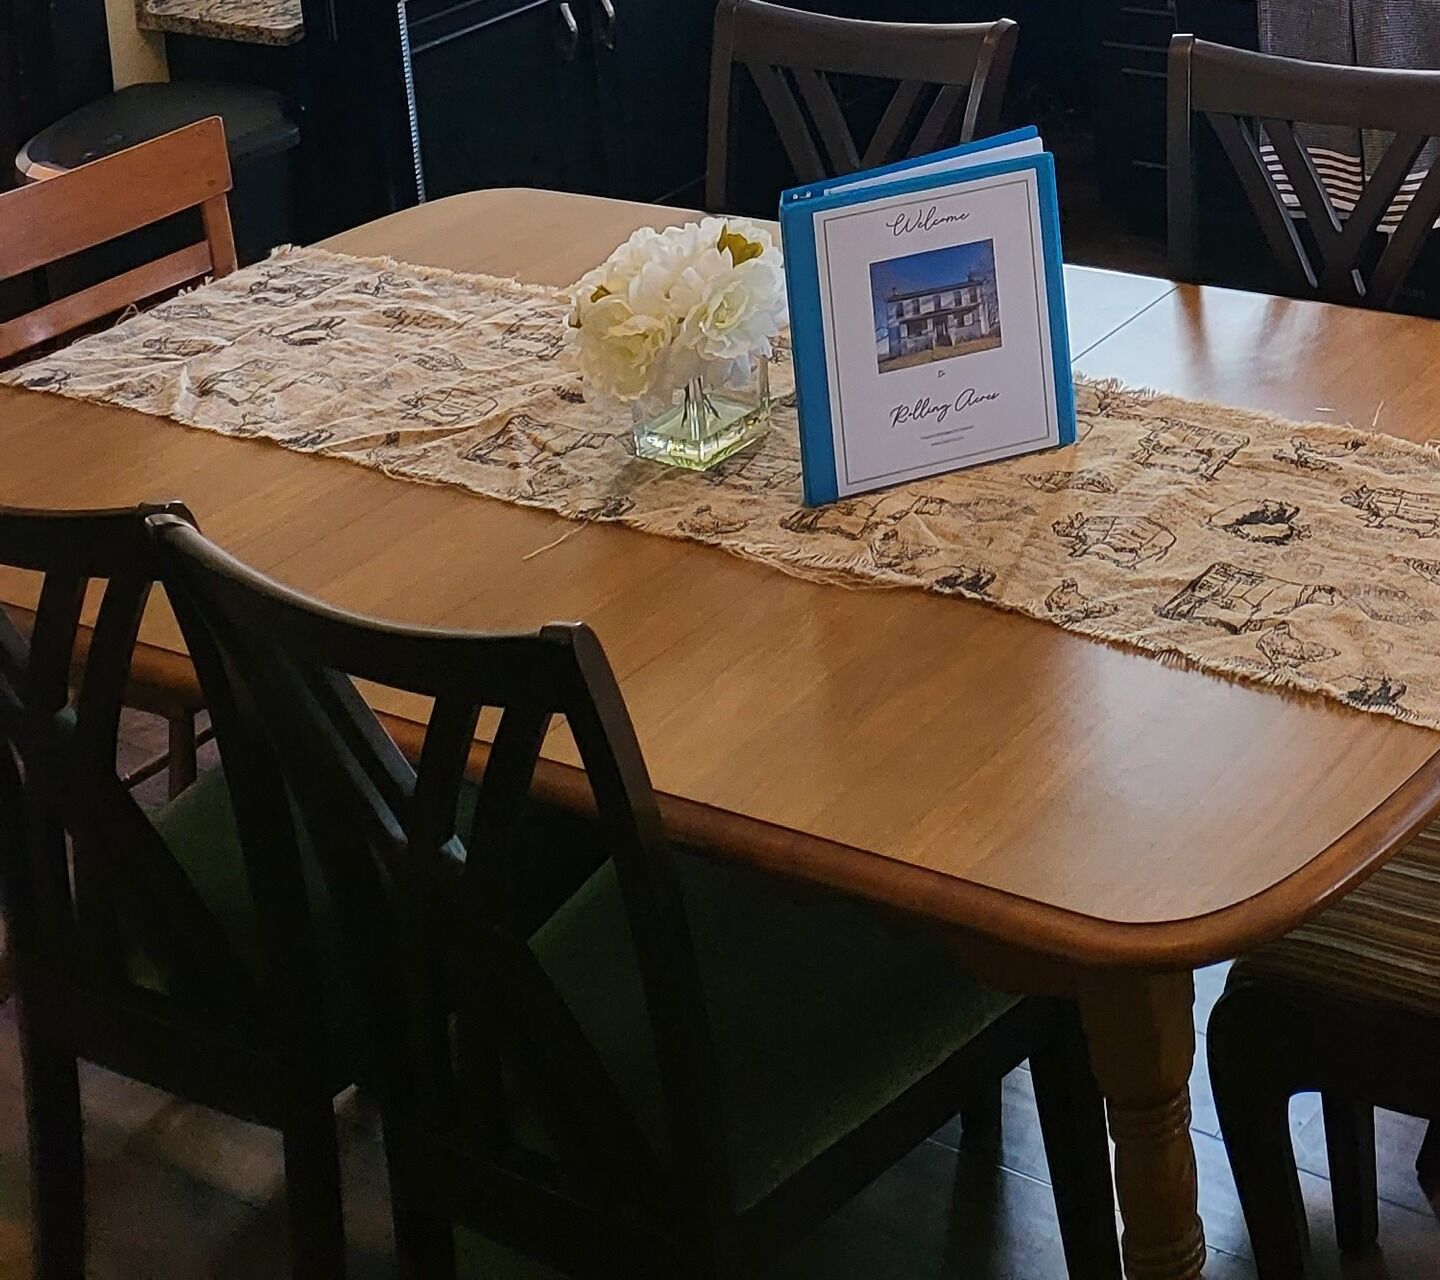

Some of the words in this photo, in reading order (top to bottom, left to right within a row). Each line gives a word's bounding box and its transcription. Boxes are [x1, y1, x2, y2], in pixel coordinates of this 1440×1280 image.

[886, 206, 970, 236] Welcome
[890, 397, 952, 429] Rolling
[954, 388, 1000, 412] Acres
